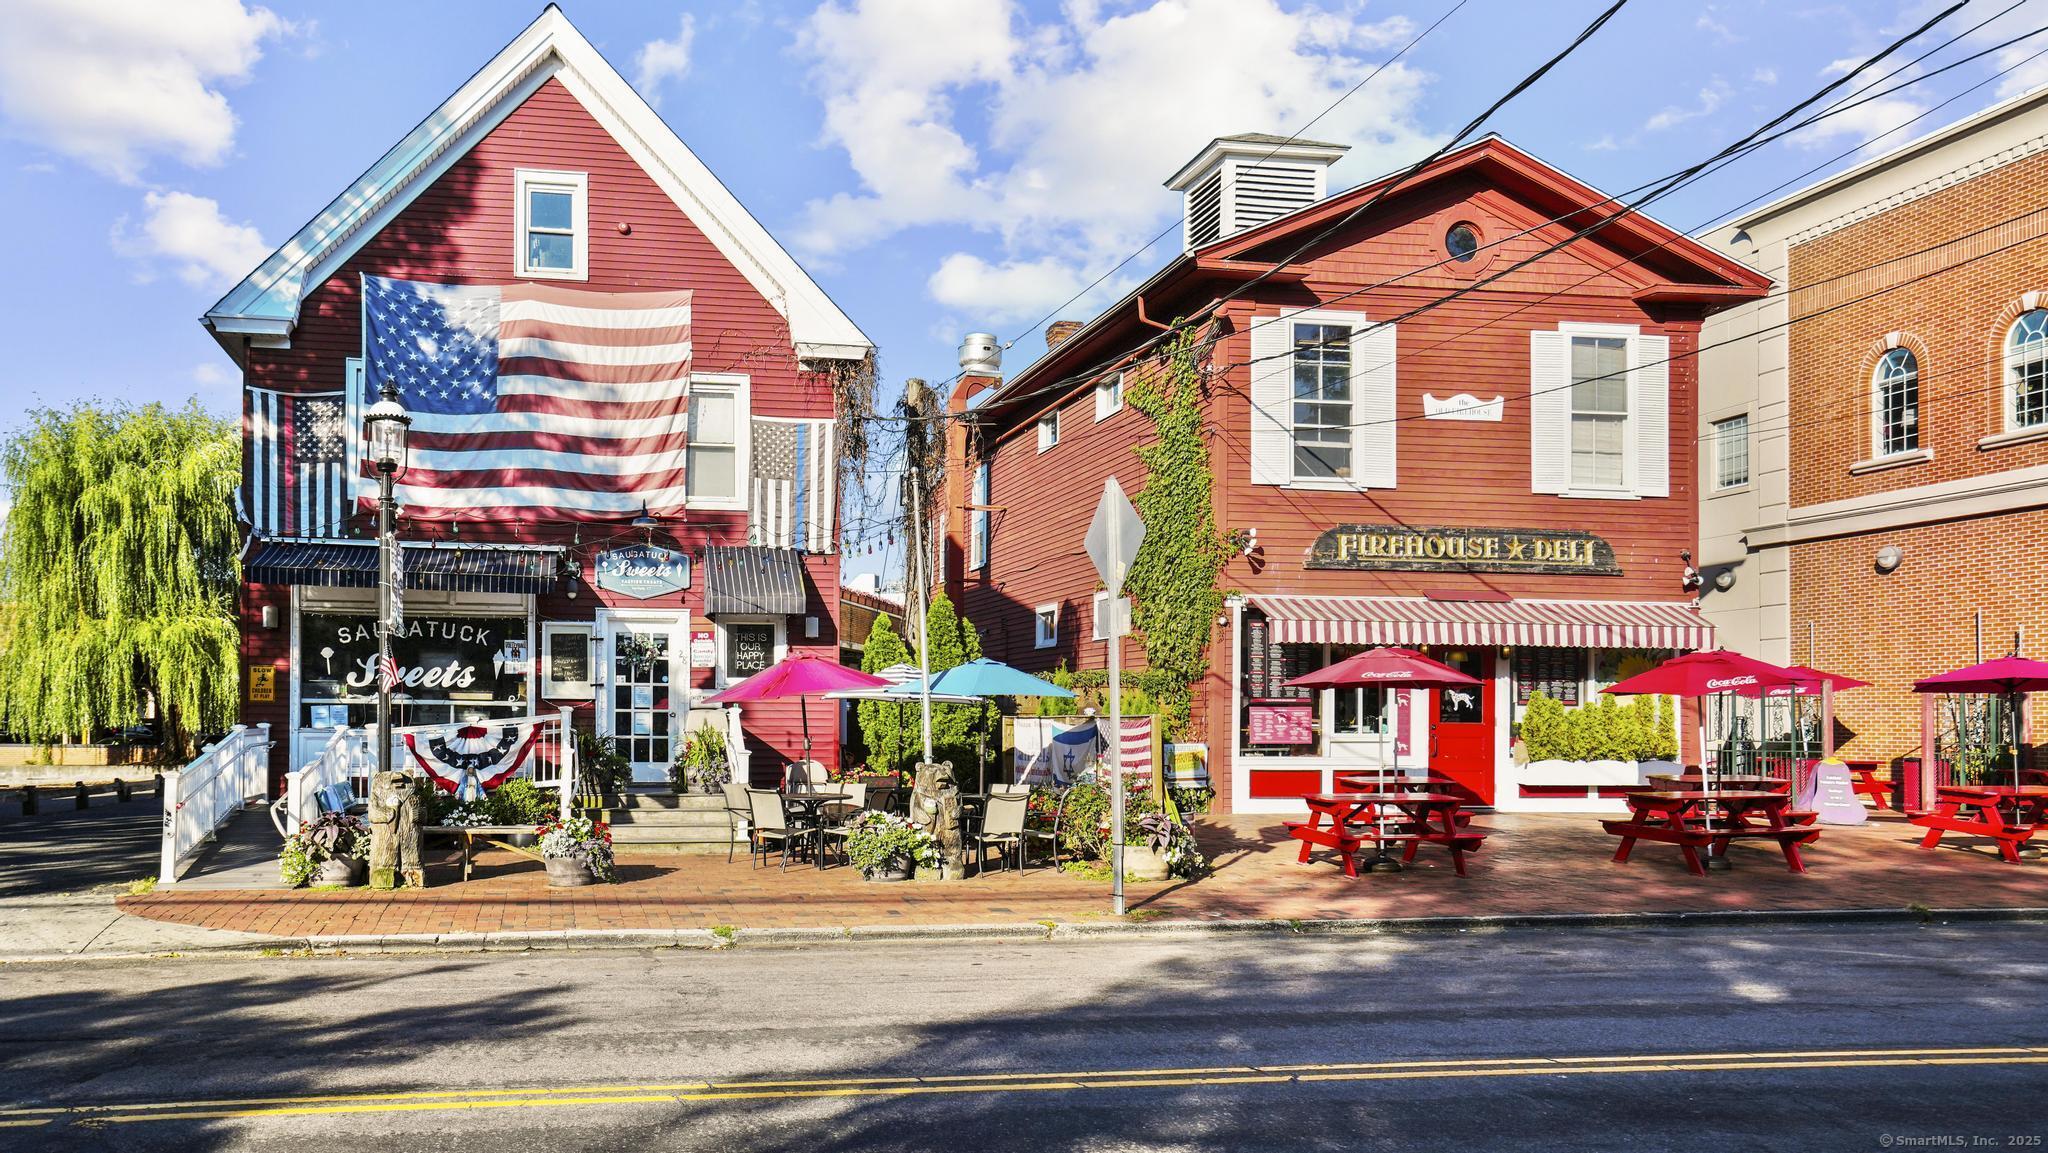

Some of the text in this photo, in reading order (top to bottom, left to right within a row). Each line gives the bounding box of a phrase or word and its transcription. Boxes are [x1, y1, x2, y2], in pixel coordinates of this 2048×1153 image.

[1337, 534, 1594, 565] FIREHOUSE DELI
[612, 560, 672, 577] Sweets
[736, 633, 767, 642] THIS IS
[737, 651, 765, 660] HAPPY
[736, 661, 765, 670] PLACE
[1706, 675, 1758, 689] Coca-Cola
